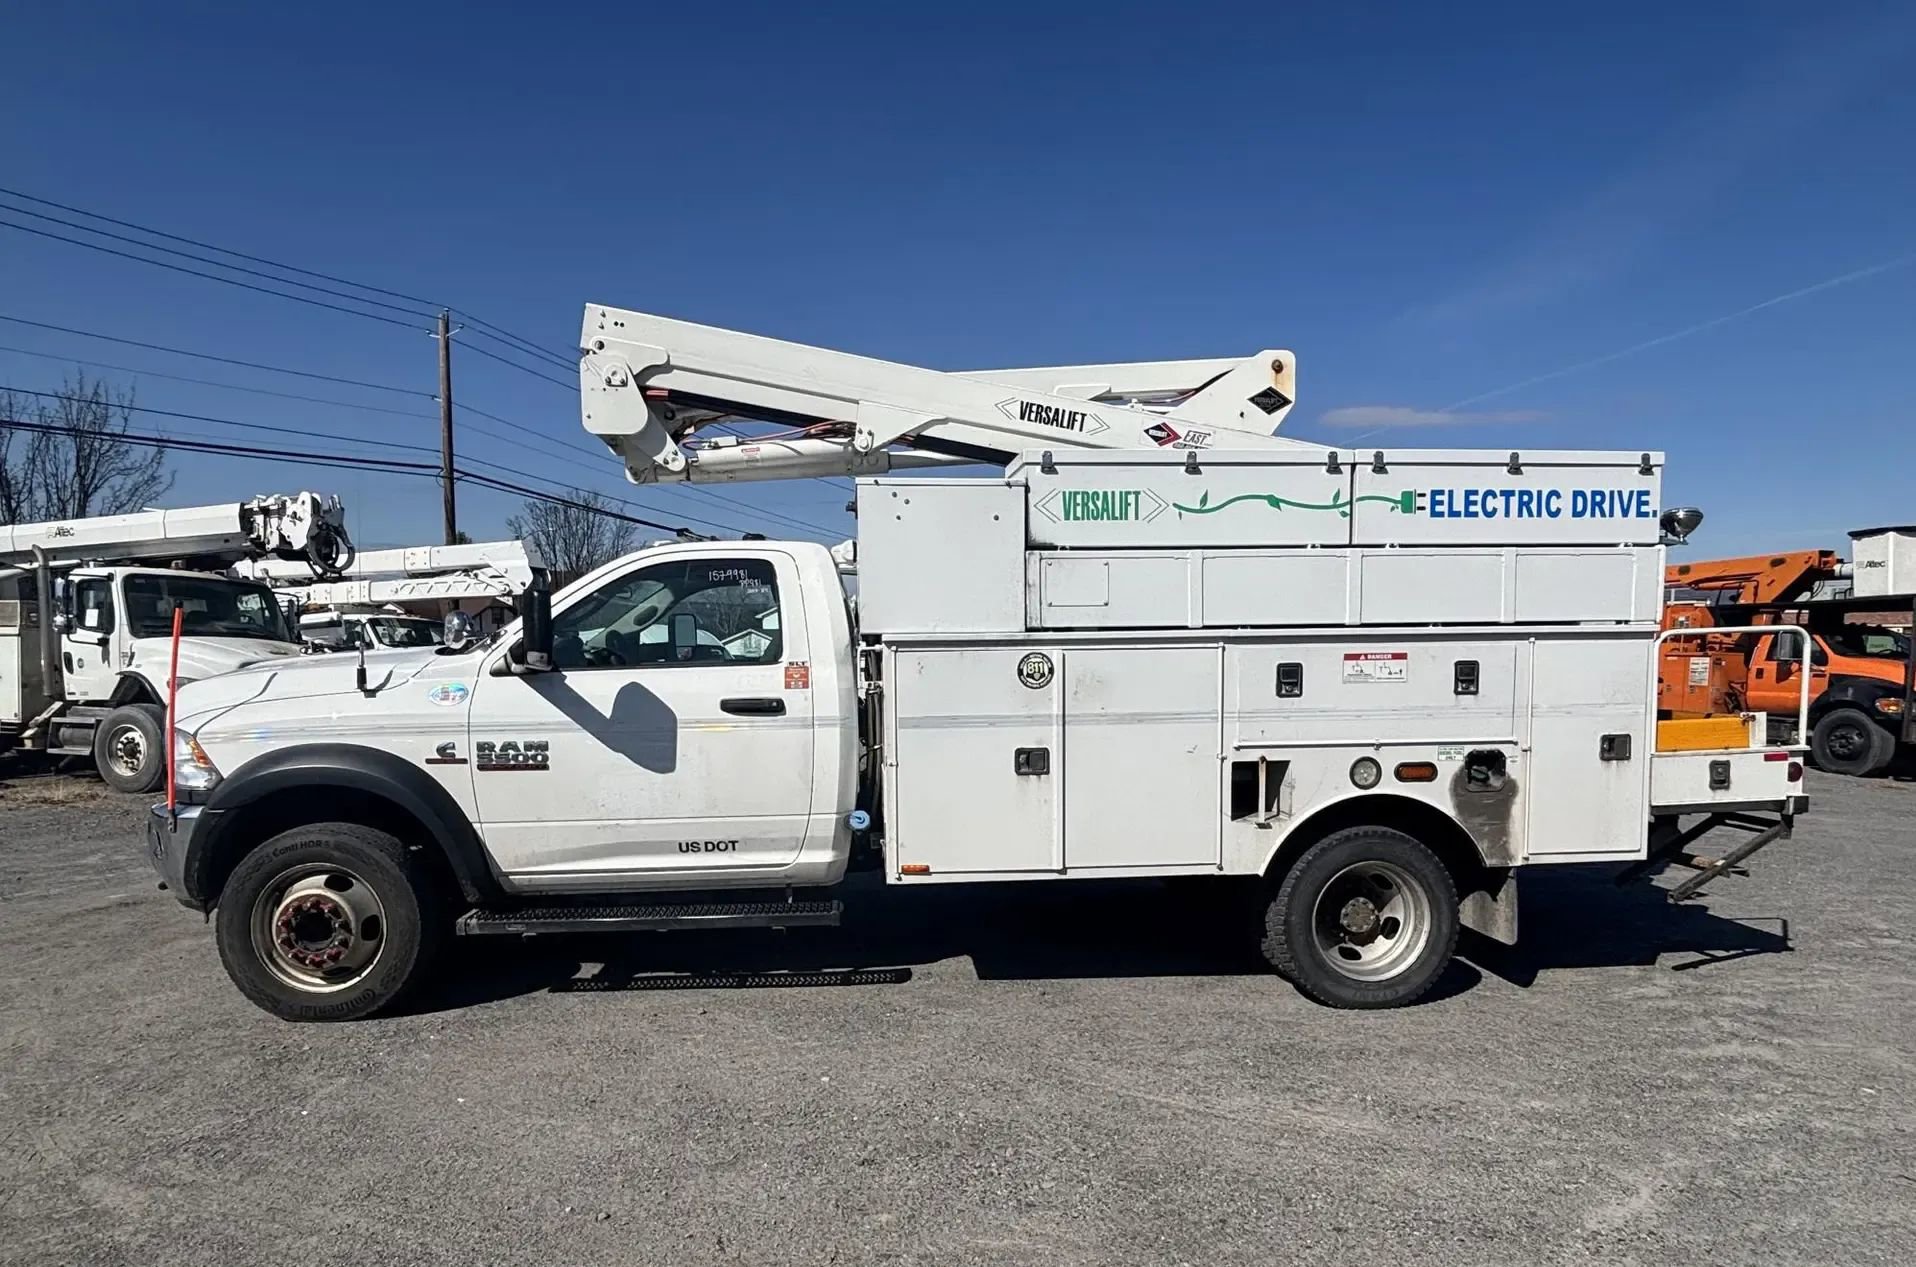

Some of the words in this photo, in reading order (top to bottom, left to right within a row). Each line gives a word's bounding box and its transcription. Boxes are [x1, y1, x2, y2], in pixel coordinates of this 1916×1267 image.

[1019, 400, 1088, 433] VERSALIFT
[1183, 430, 1209, 446] EAST
[1061, 490, 1142, 521] VERSALIFT
[1429, 489, 1562, 519] ELECTRIC
[1571, 489, 1658, 518] DRIVE.
[1027, 662, 1045, 674] 811
[476, 740, 549, 753] RAM
[476, 752, 550, 764] 5500
[272, 843, 298, 858] Conti
[678, 841, 702, 854] US
[704, 840, 739, 852] DOT
